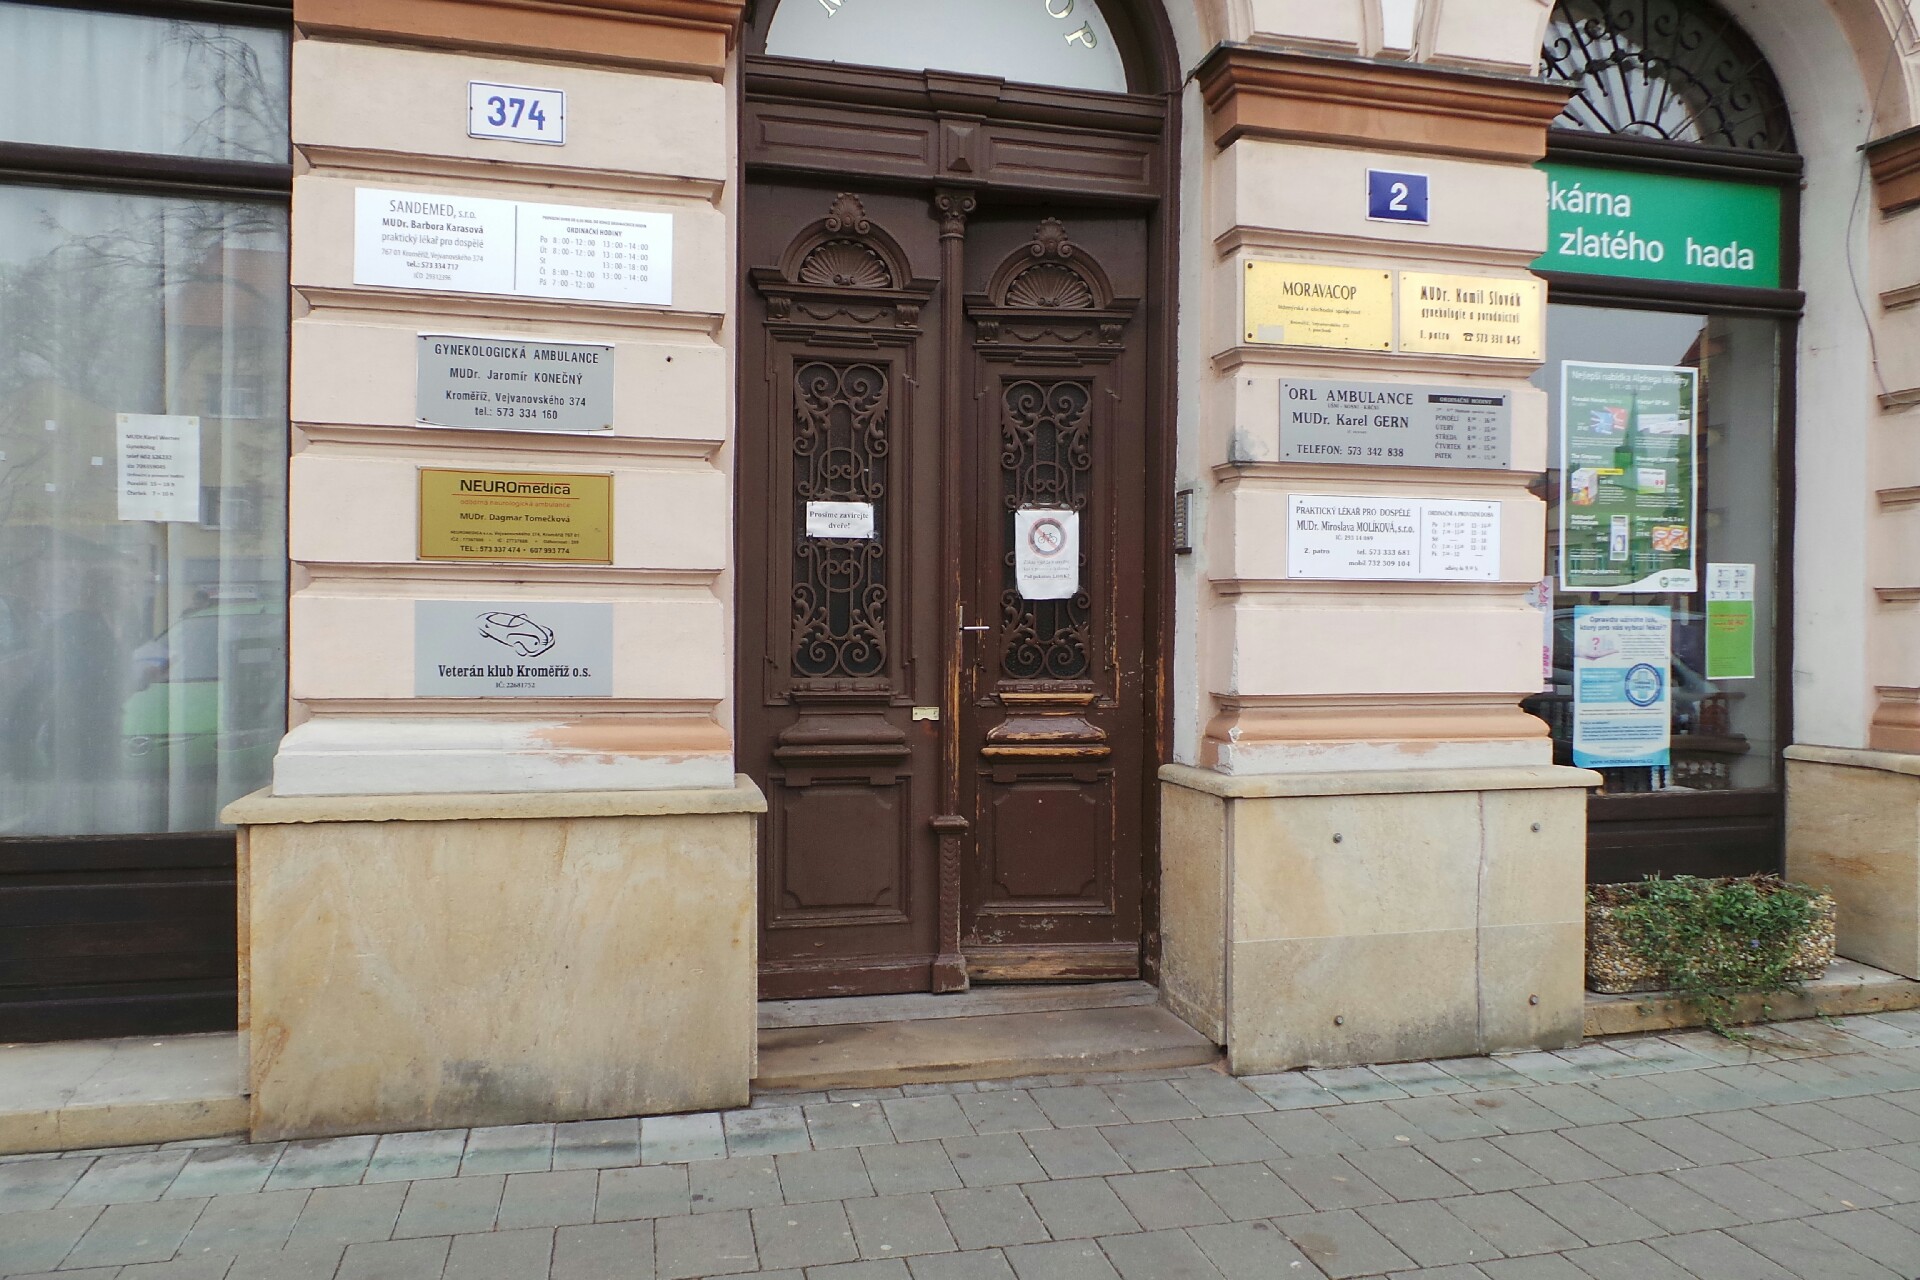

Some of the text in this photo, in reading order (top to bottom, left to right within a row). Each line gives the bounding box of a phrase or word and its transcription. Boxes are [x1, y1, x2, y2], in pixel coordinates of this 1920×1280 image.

[488, 96, 545, 130] 374
[1390, 183, 1408, 211] 2
[1547, 181, 1631, 217] kárna
[390, 200, 476, 219] SANDEMED, s.r.o.
[383, 218, 483, 234] MUDr. Barbora Karasová
[567, 227, 622, 237] ORDINAČNÍ HODINY
[382, 233, 483, 248] praktický lékař pro dospělé
[1559, 227, 1754, 270] zlatého hada
[1282, 281, 1356, 300] MORAVACOP
[1420, 286, 1520, 306] MUDr. Kamil Slovák
[1422, 308, 1519, 323] gynekologie a porodnictví
[1428, 332, 1449, 340] patro
[1476, 333, 1488, 343] 573
[435, 343, 599, 363] GYNEKOLOGICKÁ AMBULANCE
[450, 367, 583, 385] MUDr. Jaromír KONEČNÝ
[495, 392, 565, 406] Vejvanovského
[569, 397, 586, 406] 374
[1289, 388, 1414, 405] ORL AMBULANCE
[475, 407, 558, 419] tel.: 573 334 160
[1292, 412, 1409, 428] MUDr. Karel GERN
[1297, 444, 1404, 457] TELEFON: 573 342 838
[460, 479, 570, 495] NEUROmedica
[489, 514, 522, 522] Dagmar
[840, 512, 868, 520] zavírejte
[1296, 506, 1411, 517] PRAKTICKÝ LÉKAŘ PRO DOSPĚLÉ
[1297, 520, 1319, 531] MUDr.
[1321, 521, 1354, 532] Miroslava
[438, 664, 591, 678] Veterán klub Kroměříž o.s.
